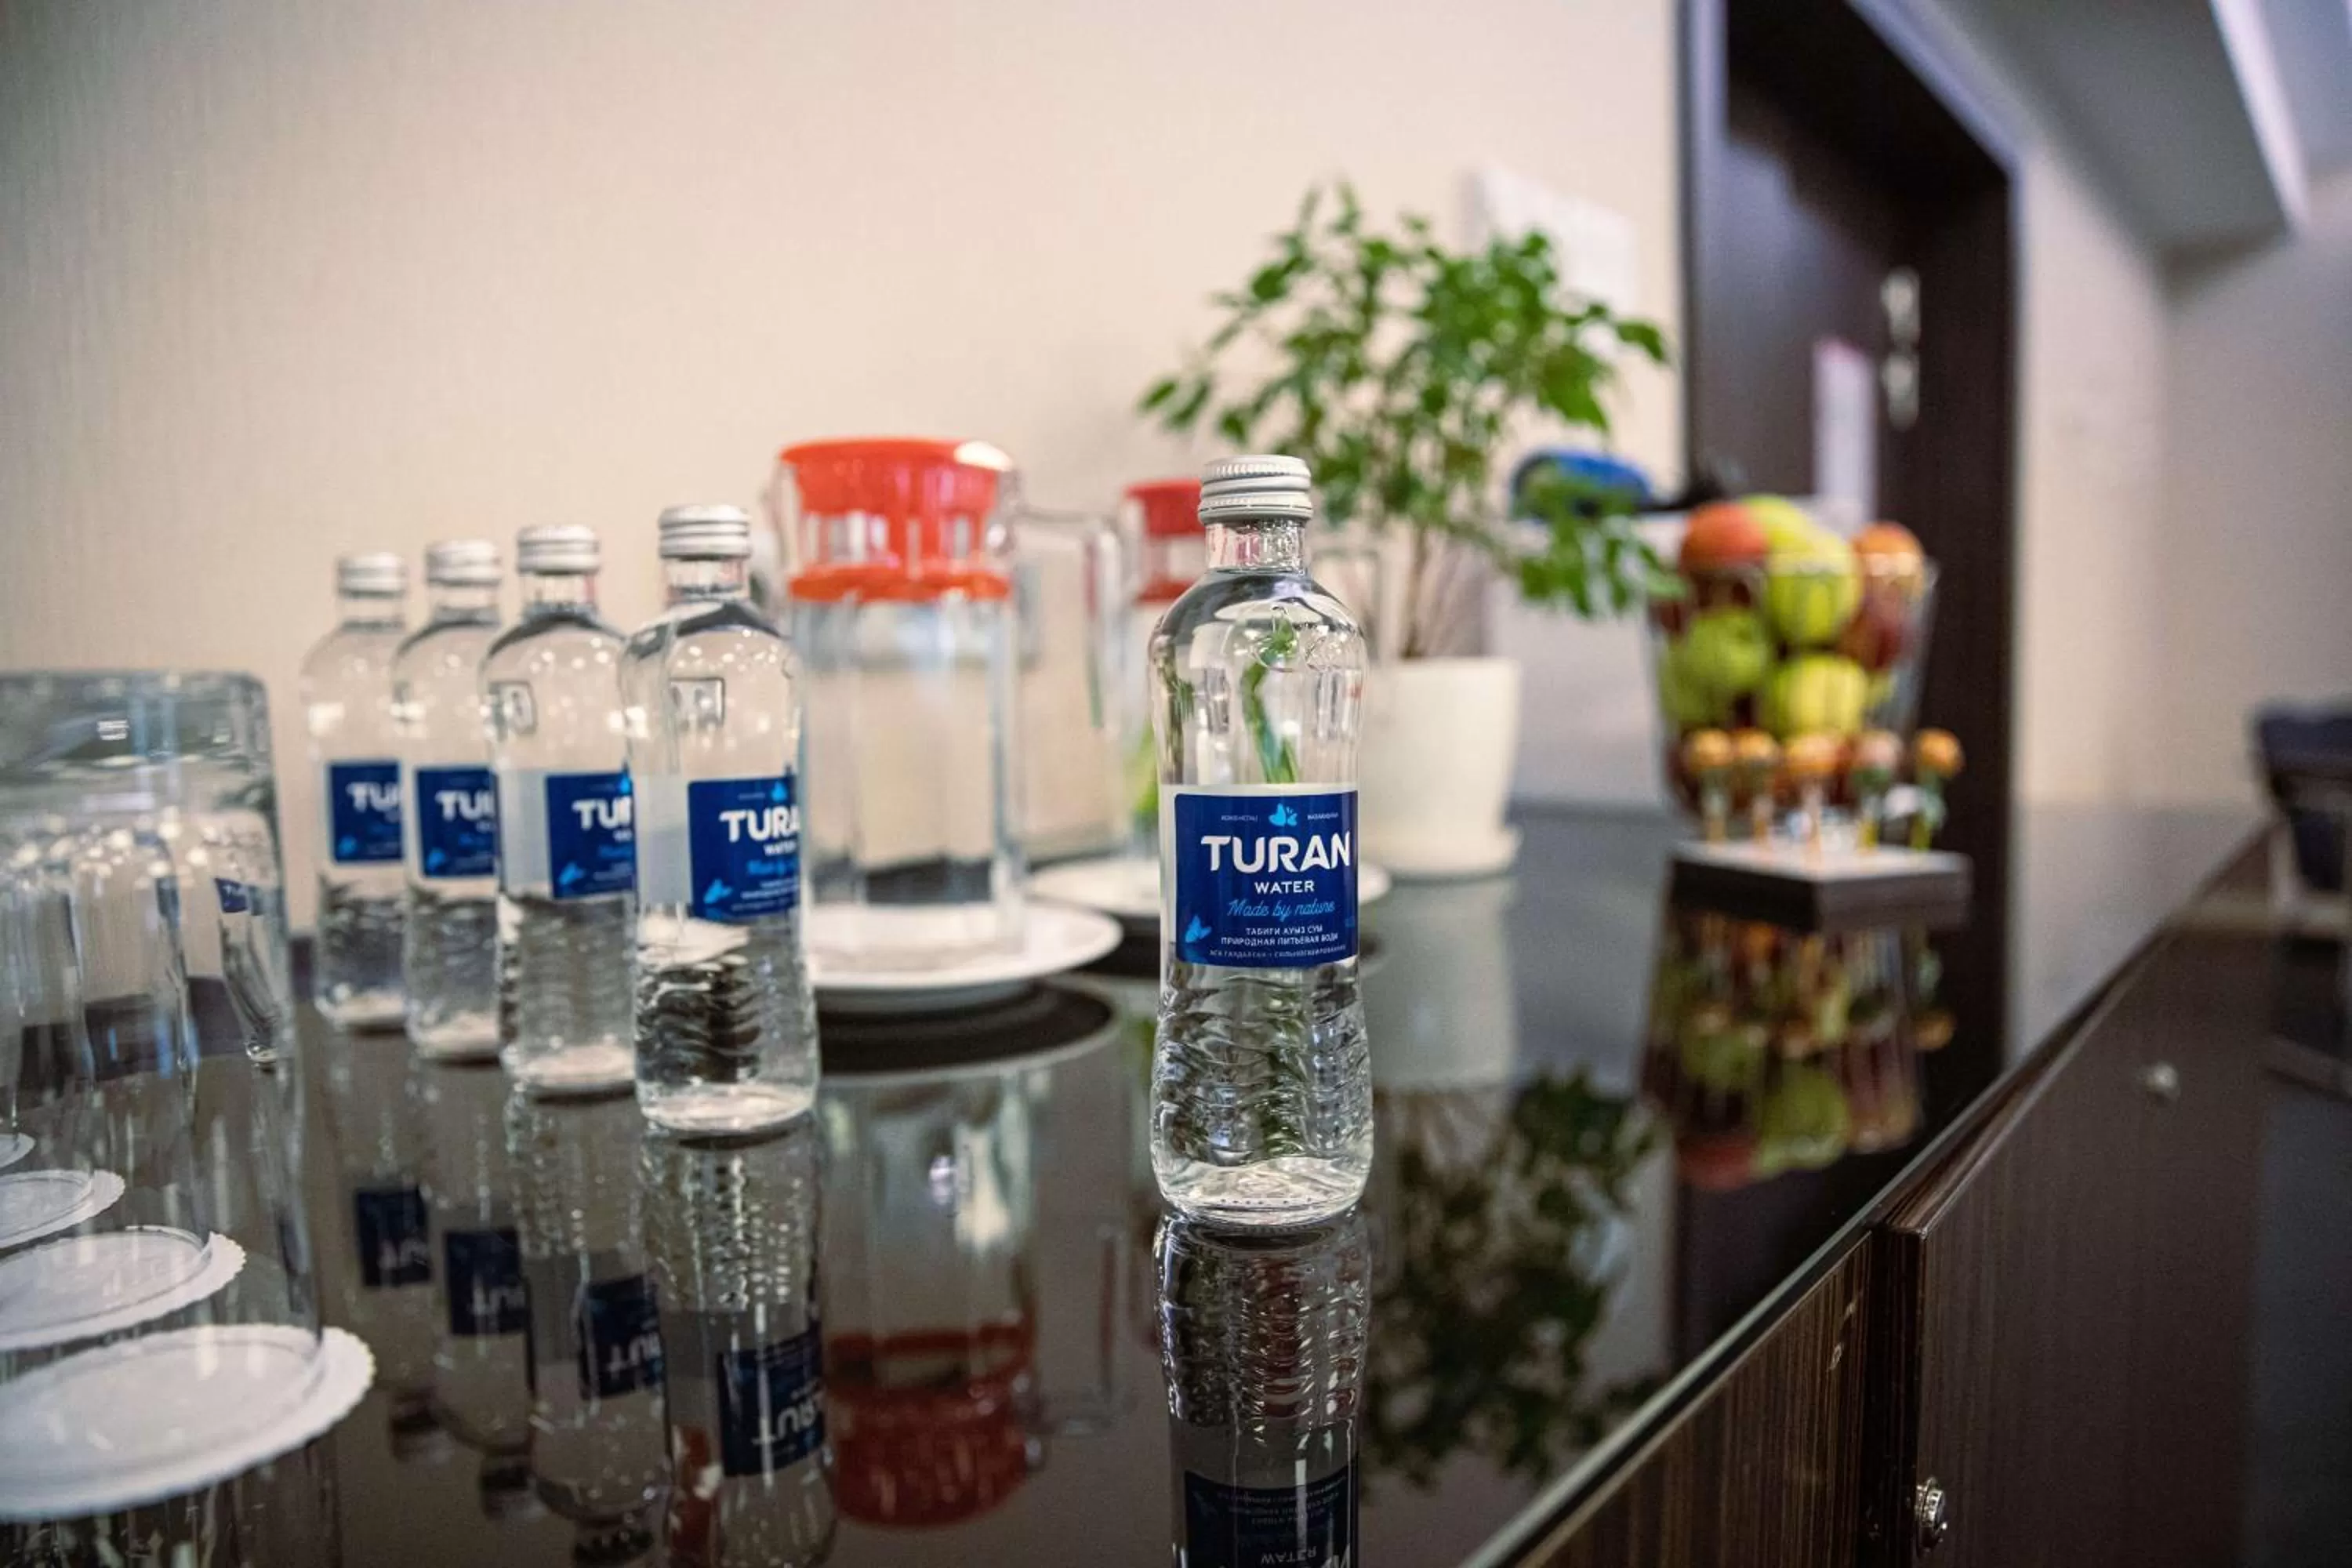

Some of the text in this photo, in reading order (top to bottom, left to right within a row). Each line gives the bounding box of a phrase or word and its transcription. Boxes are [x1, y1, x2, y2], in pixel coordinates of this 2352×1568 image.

[1200, 831, 1351, 874] TURAN
[1254, 880, 1316, 895] WATER
[1226, 897, 1335, 922] Made by nature
